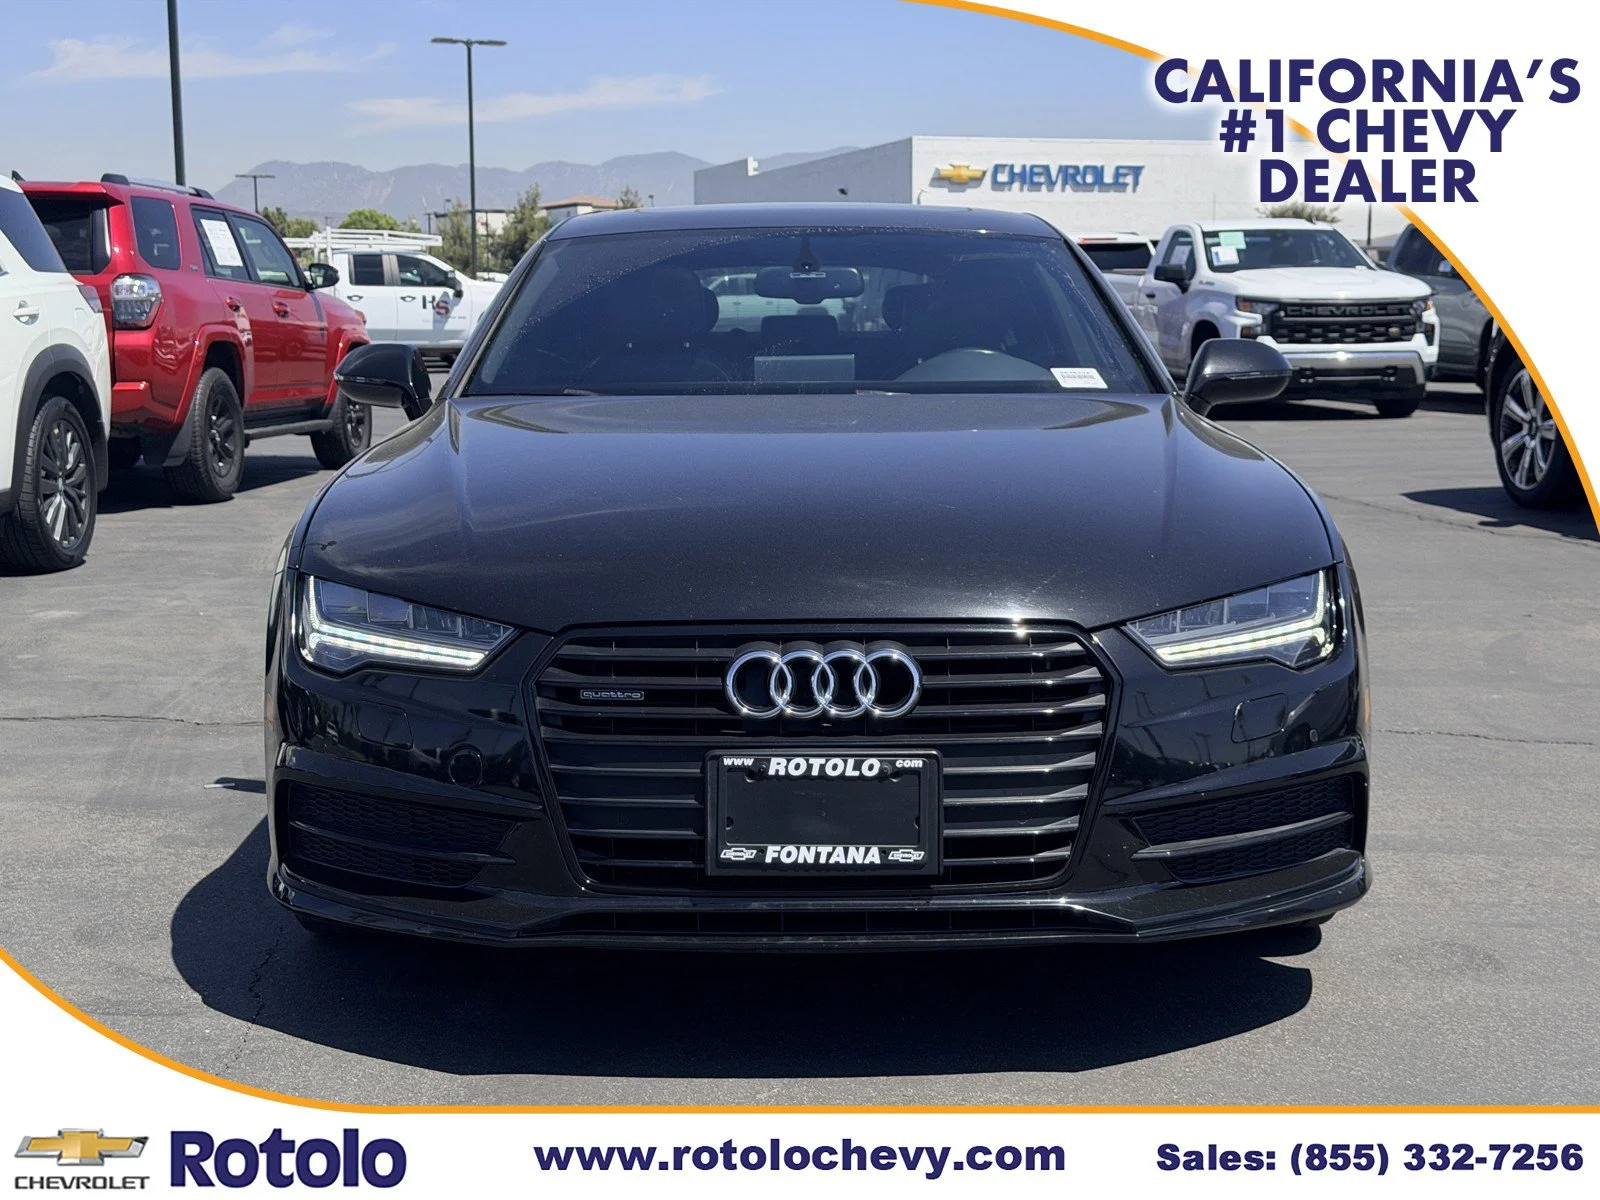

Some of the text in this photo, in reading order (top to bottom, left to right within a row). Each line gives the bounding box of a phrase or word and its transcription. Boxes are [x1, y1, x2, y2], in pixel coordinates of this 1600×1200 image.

[992, 163, 1144, 190] CHEVROLET
[1286, 304, 1412, 316] CHEVROLET
[583, 691, 641, 699] quattro
[723, 758, 923, 777] www ROTOLO com
[764, 846, 881, 864] FONTANA
